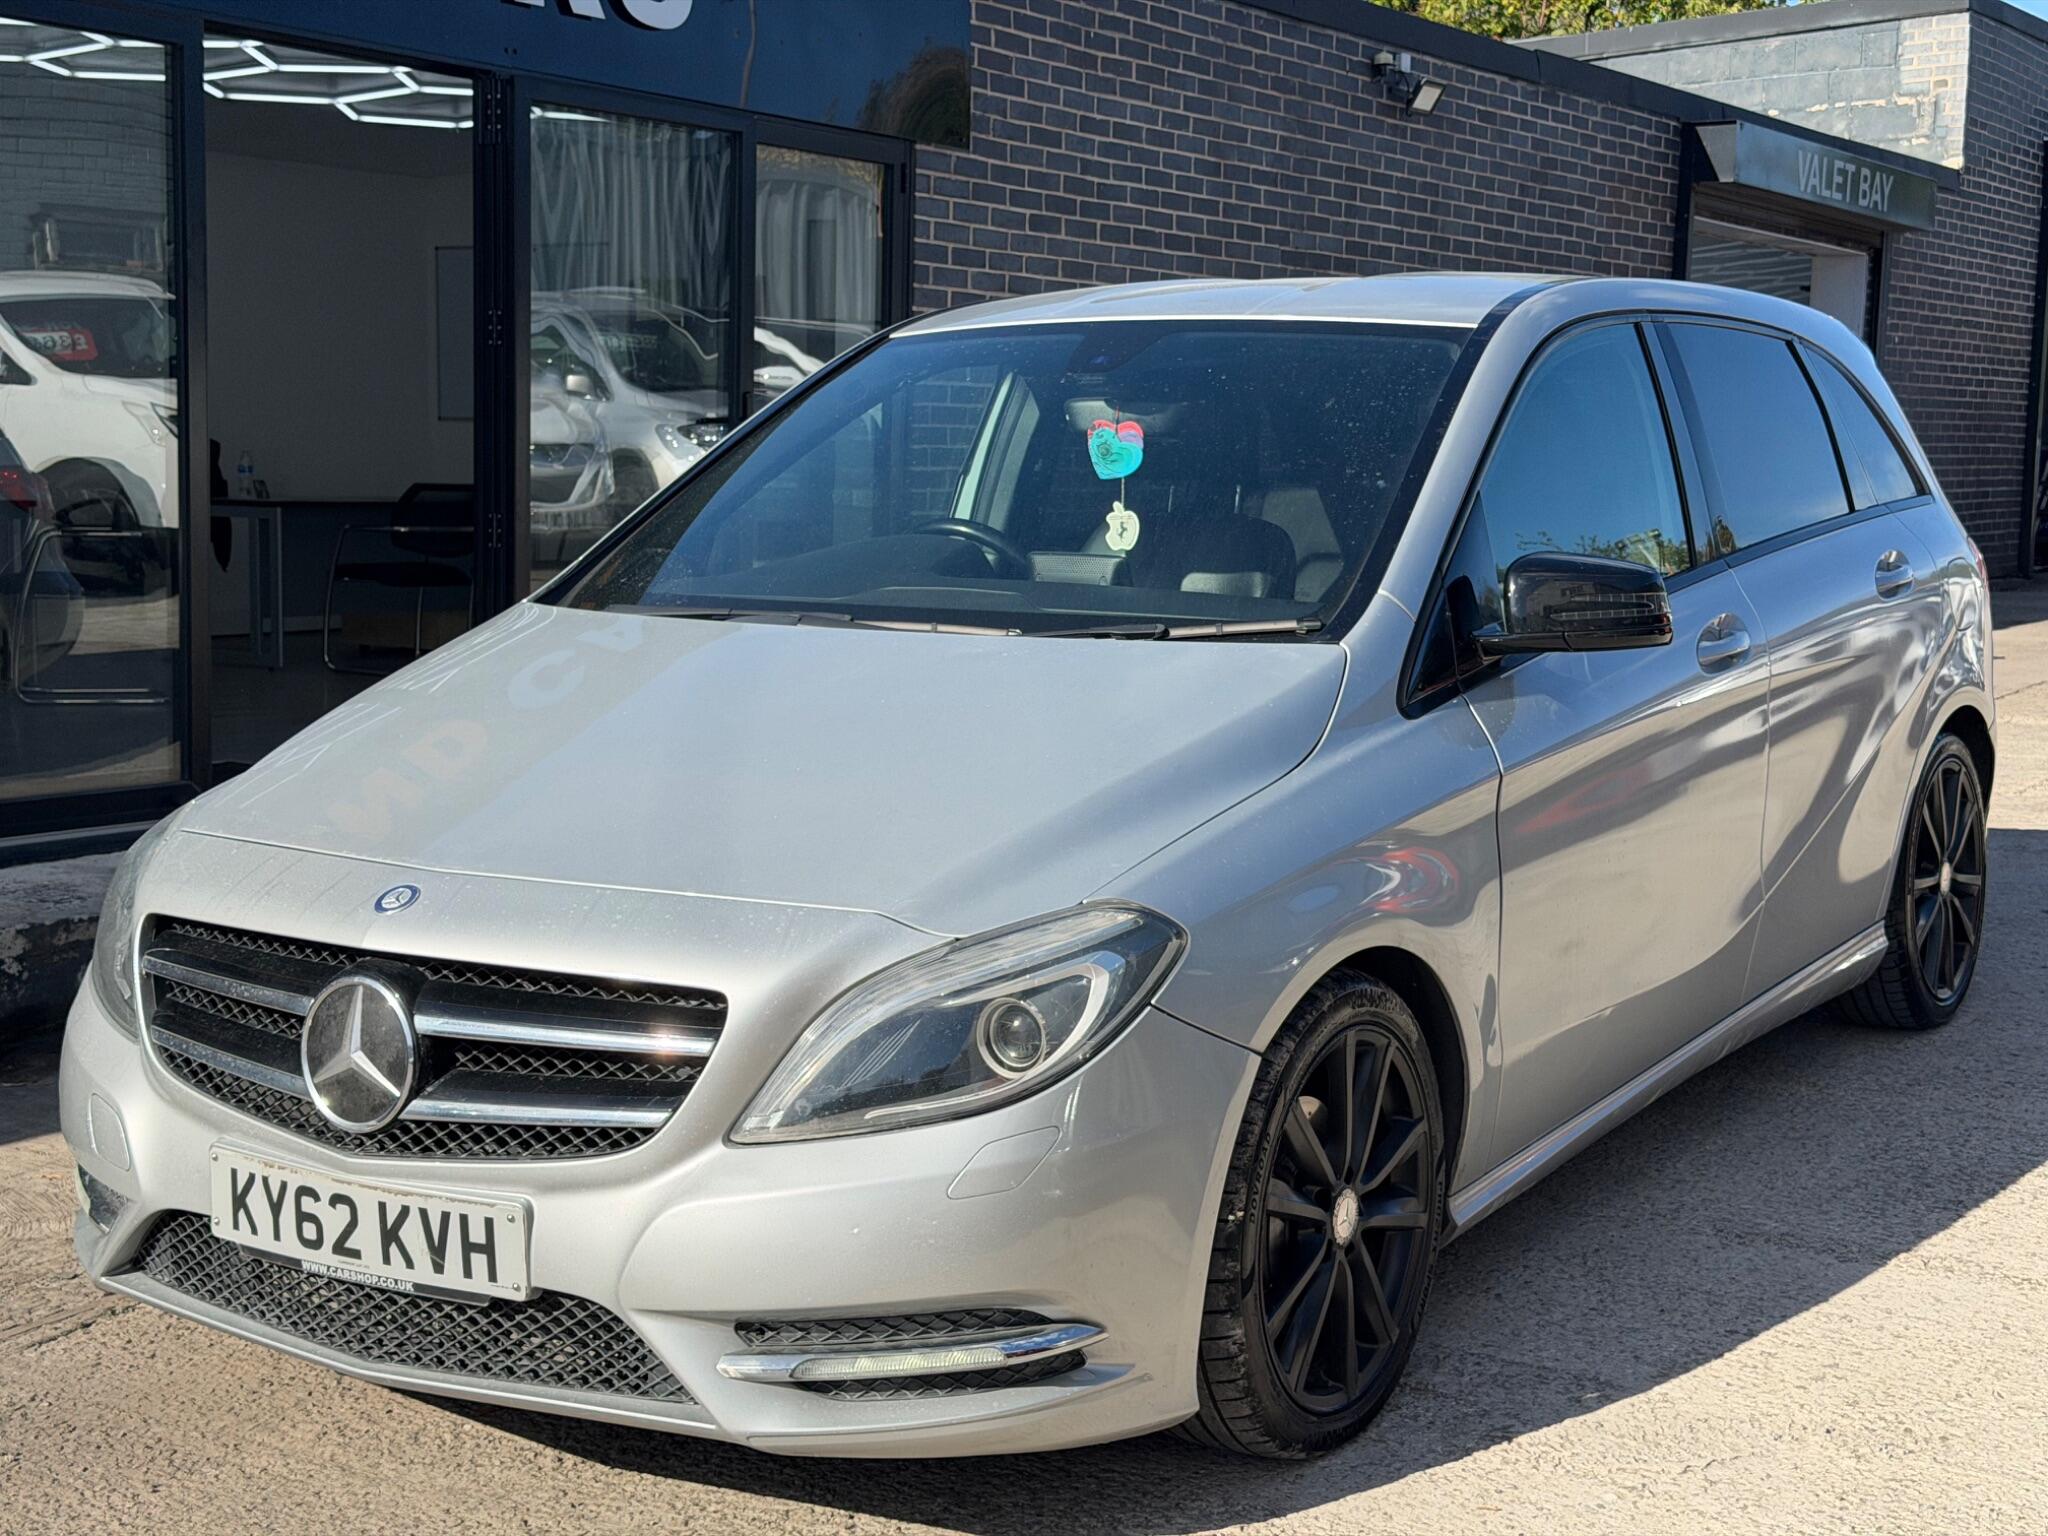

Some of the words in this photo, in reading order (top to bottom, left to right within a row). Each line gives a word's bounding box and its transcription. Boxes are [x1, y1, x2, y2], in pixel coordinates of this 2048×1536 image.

[1798, 150, 1856, 203] VALET
[1858, 167, 1894, 212] BAY
[1250, 1132, 1271, 1224] DOVROAD
[230, 1167, 362, 1261] KY62
[377, 1200, 498, 1283] KVH
[301, 1260, 415, 1291] WWW.CARSHOP.CO.UK
